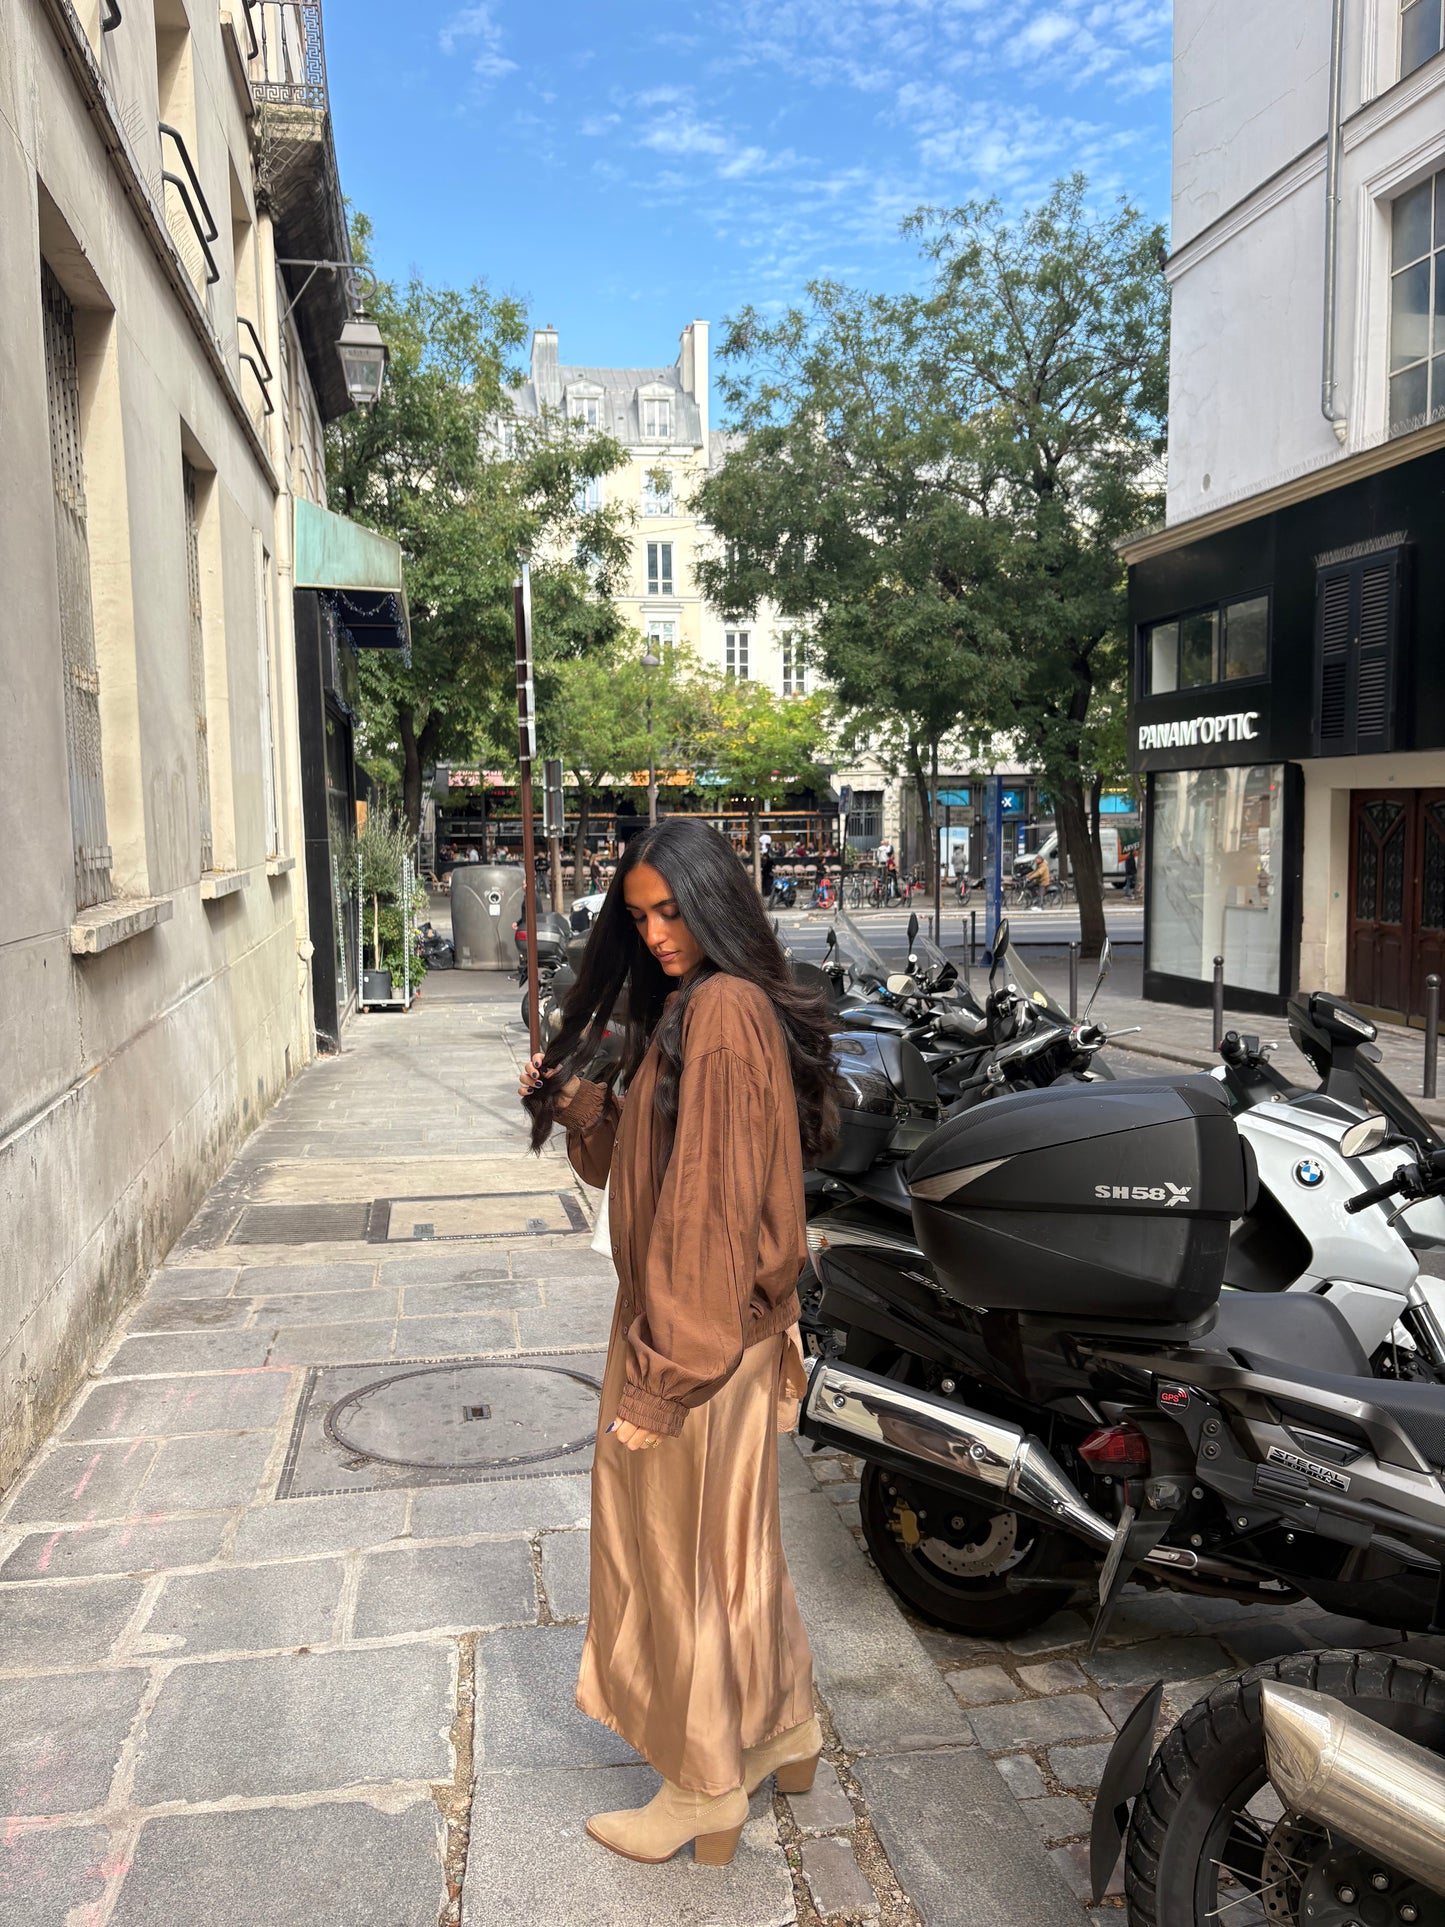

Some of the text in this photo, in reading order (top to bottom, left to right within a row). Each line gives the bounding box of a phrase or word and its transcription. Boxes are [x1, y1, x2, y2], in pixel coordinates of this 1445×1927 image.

[1138, 711, 1259, 751] PANAM'OPTIC
[1161, 1392, 1180, 1403] GPS
[1272, 1449, 1345, 1484] SPECIAL
